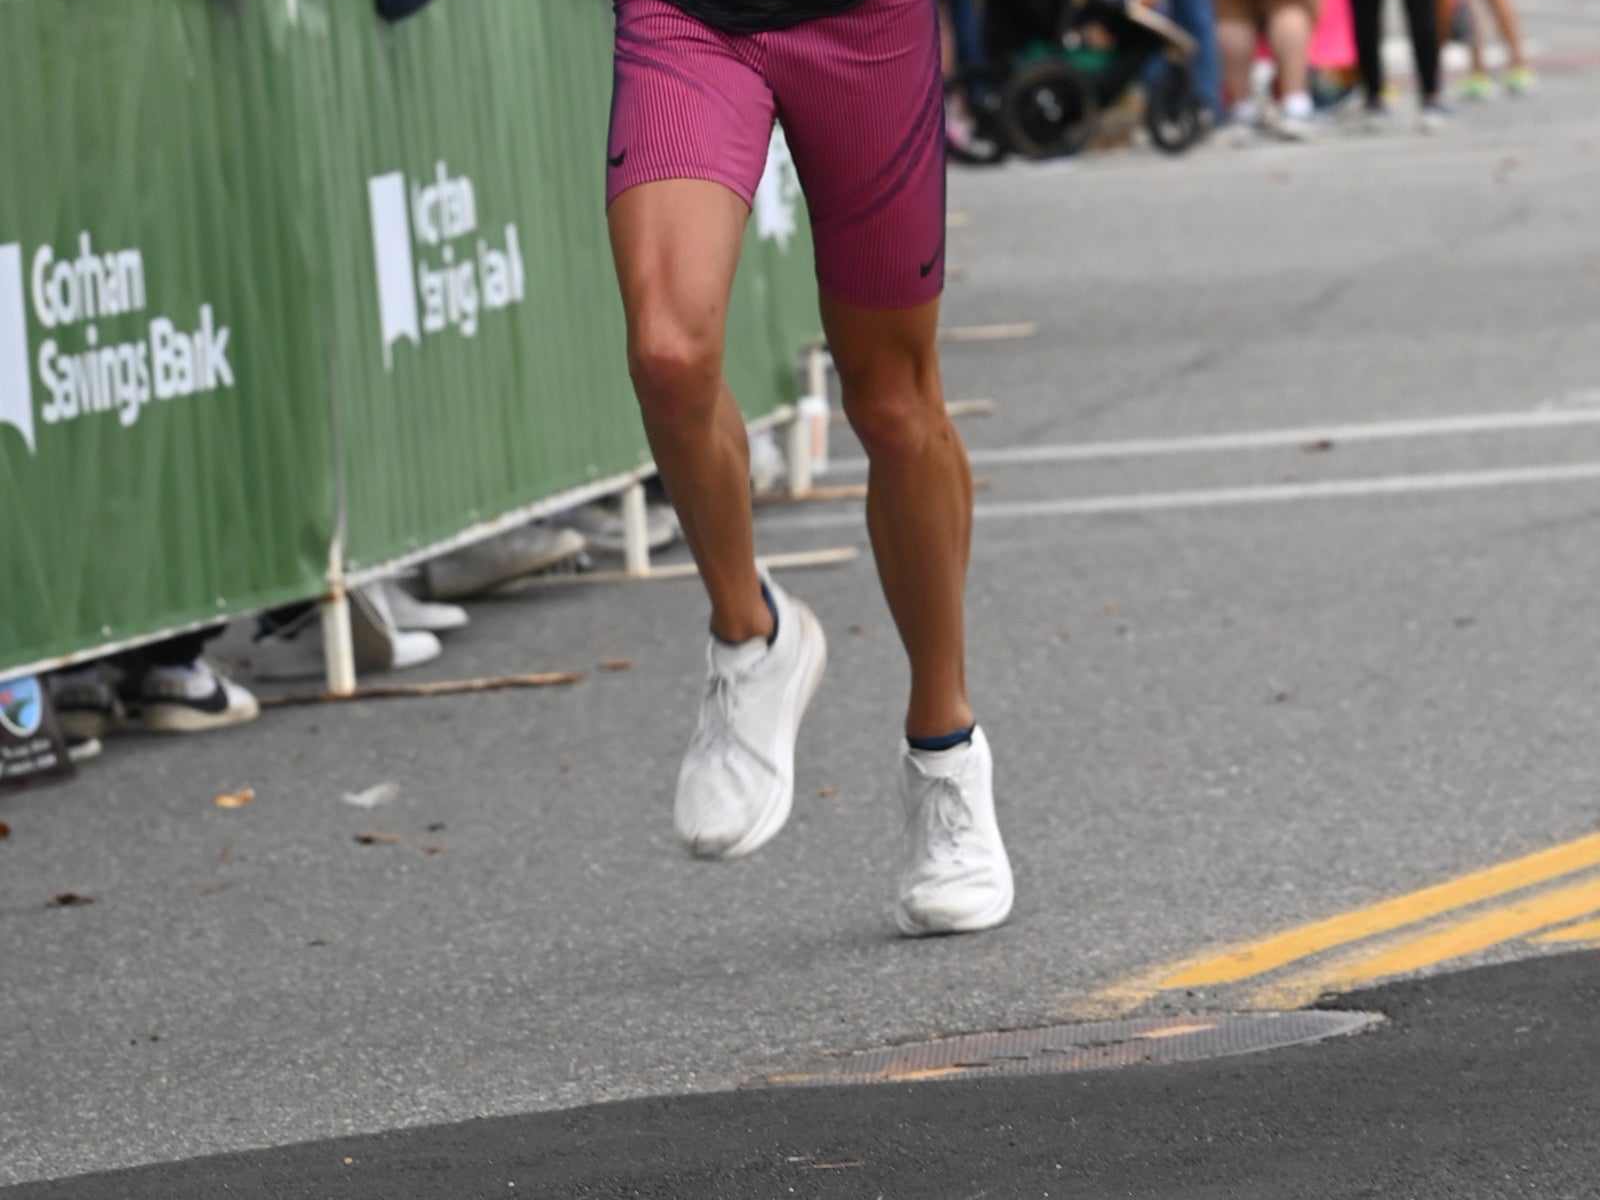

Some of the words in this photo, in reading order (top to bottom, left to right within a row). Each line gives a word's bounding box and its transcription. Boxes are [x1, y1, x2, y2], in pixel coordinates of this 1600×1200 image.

[31, 229, 146, 329] Gorham
[38, 325, 150, 427] Savings
[148, 302, 235, 400] Bank
